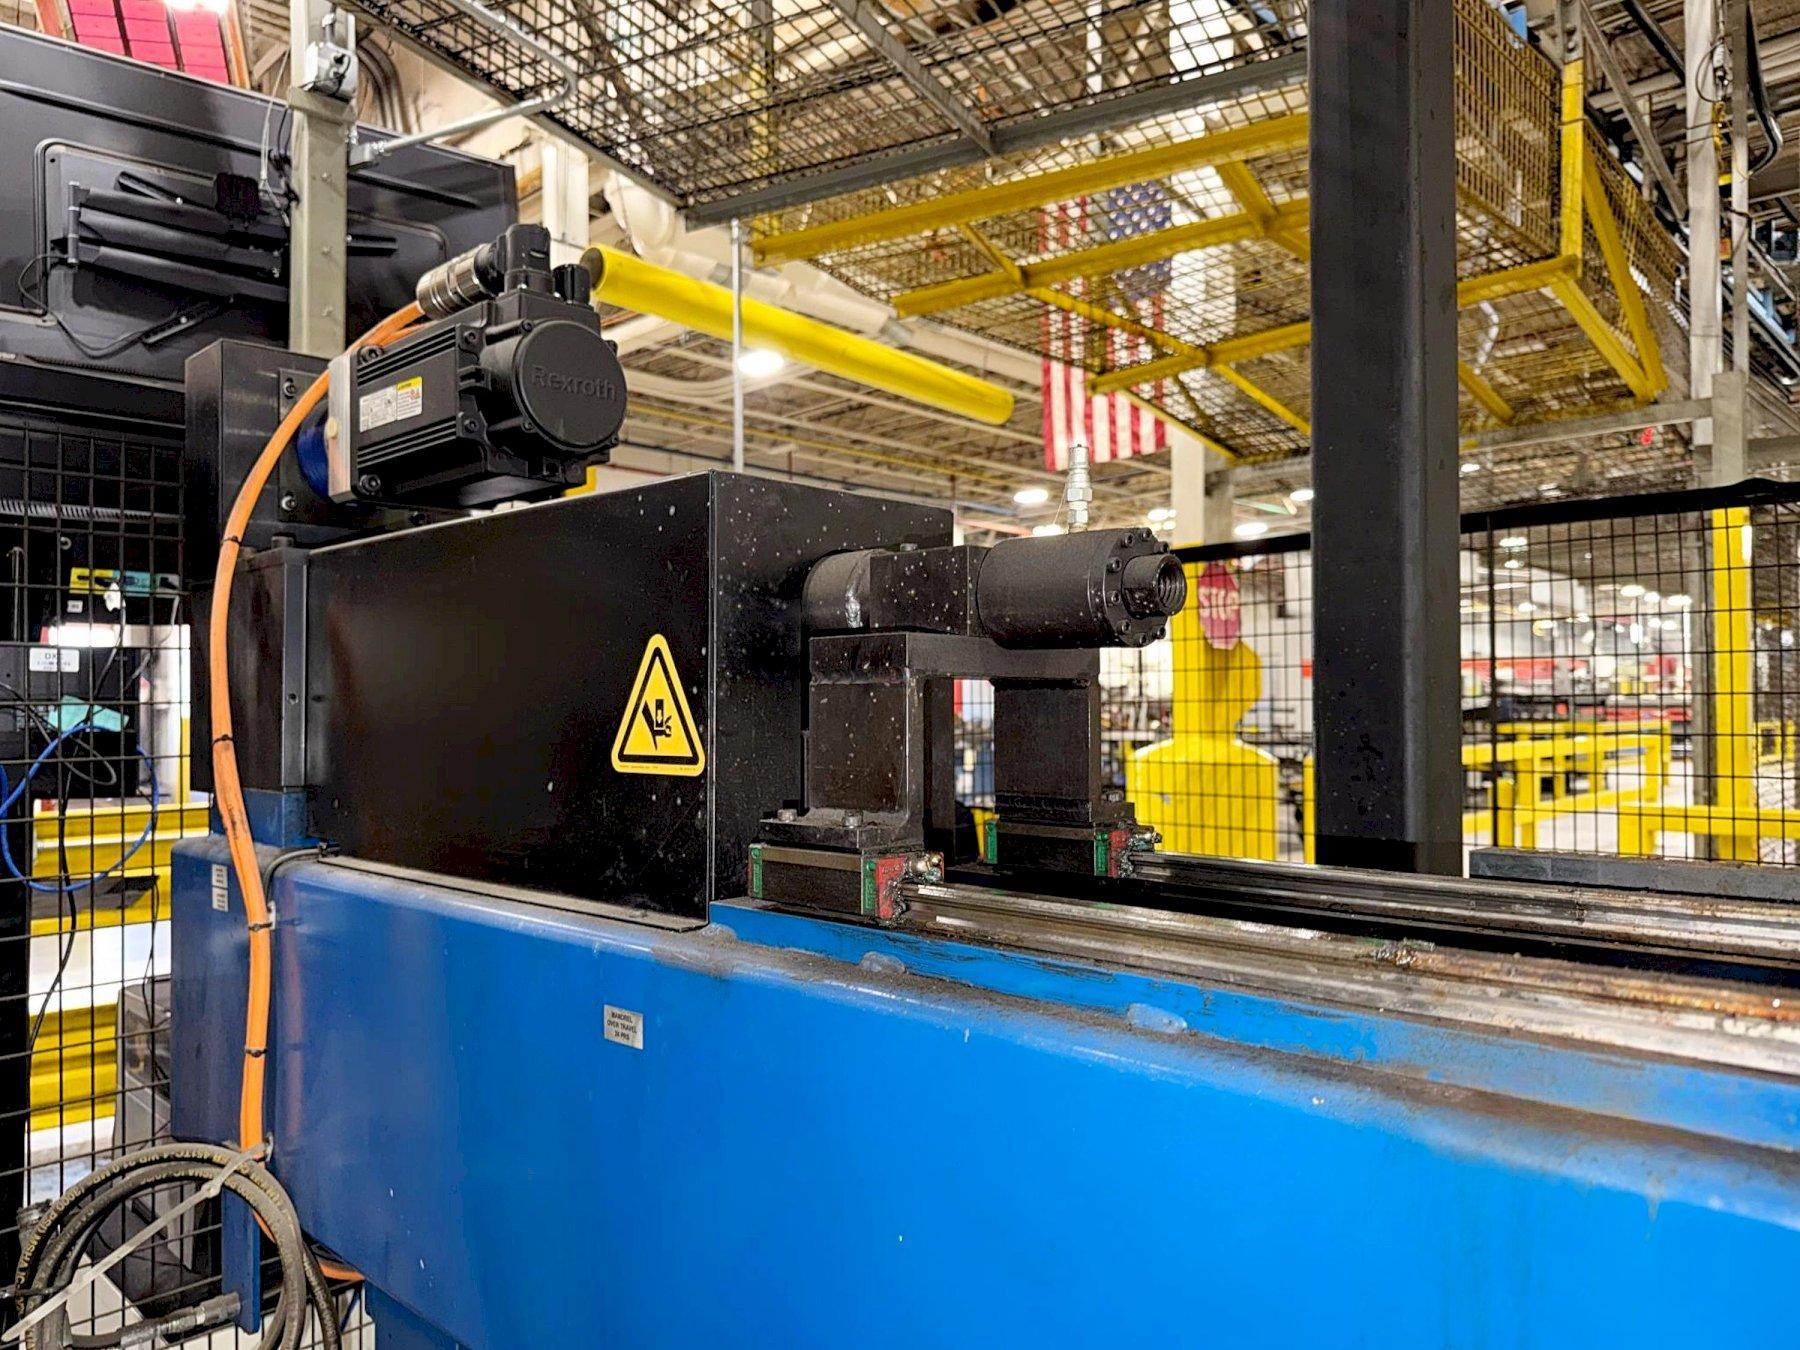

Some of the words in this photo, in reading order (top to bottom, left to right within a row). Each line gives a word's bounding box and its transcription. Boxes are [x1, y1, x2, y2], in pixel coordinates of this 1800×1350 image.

[531, 366, 616, 401] Rexroth
[1199, 587, 1240, 619] STOP
[607, 1018, 619, 1028] OVER
[620, 1022, 637, 1033] TRAVEL
[35, 1208, 58, 1234] PSI)
[18, 1232, 43, 1270] MSHA
